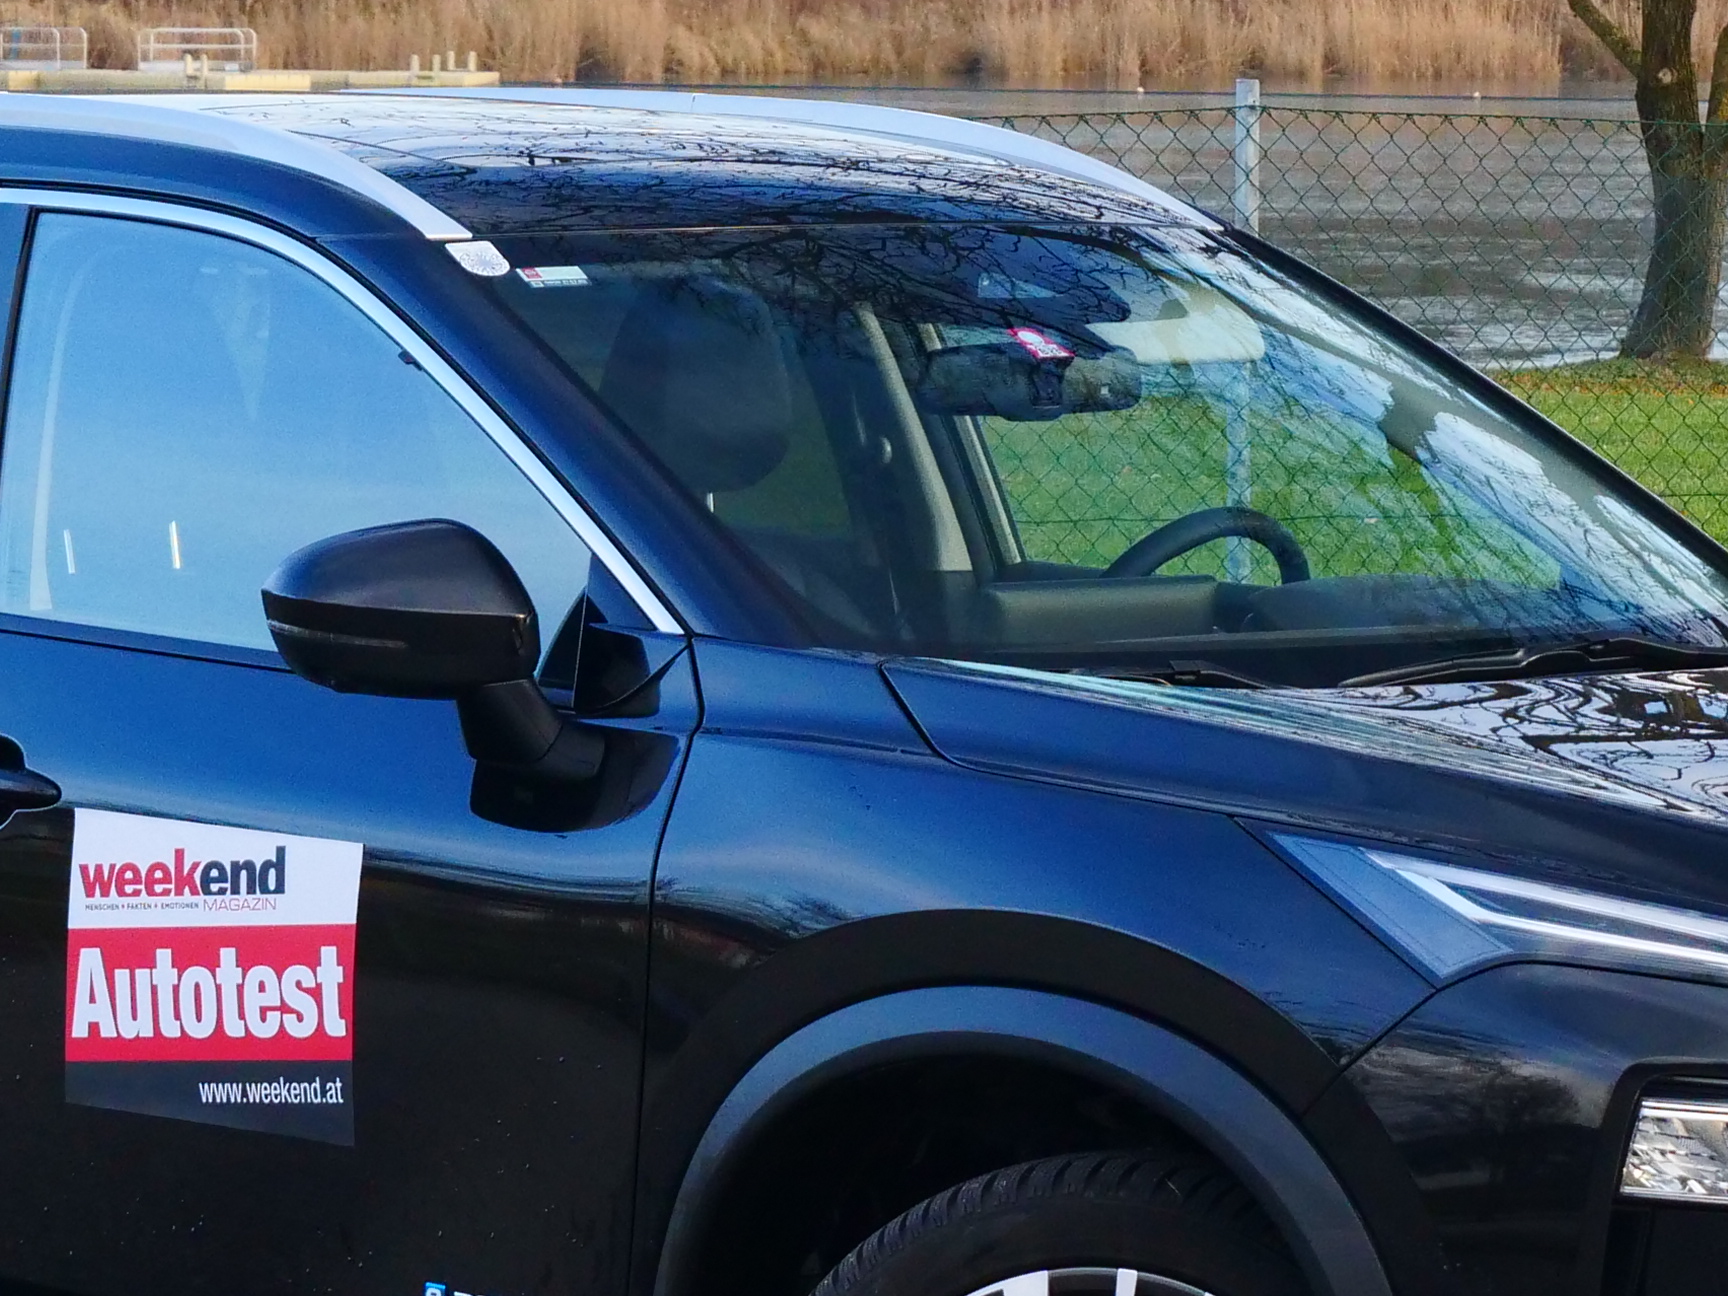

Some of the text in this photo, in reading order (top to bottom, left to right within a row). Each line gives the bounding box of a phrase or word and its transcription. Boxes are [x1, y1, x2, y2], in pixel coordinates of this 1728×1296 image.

[79, 845, 286, 898] weekend
[85, 903, 120, 911] MENSCHEN
[161, 902, 199, 910] EMOTIONEN
[203, 897, 277, 912] MAGAZIN
[72, 946, 347, 1039] Autotest
[198, 1076, 344, 1104] www.weekend.at
